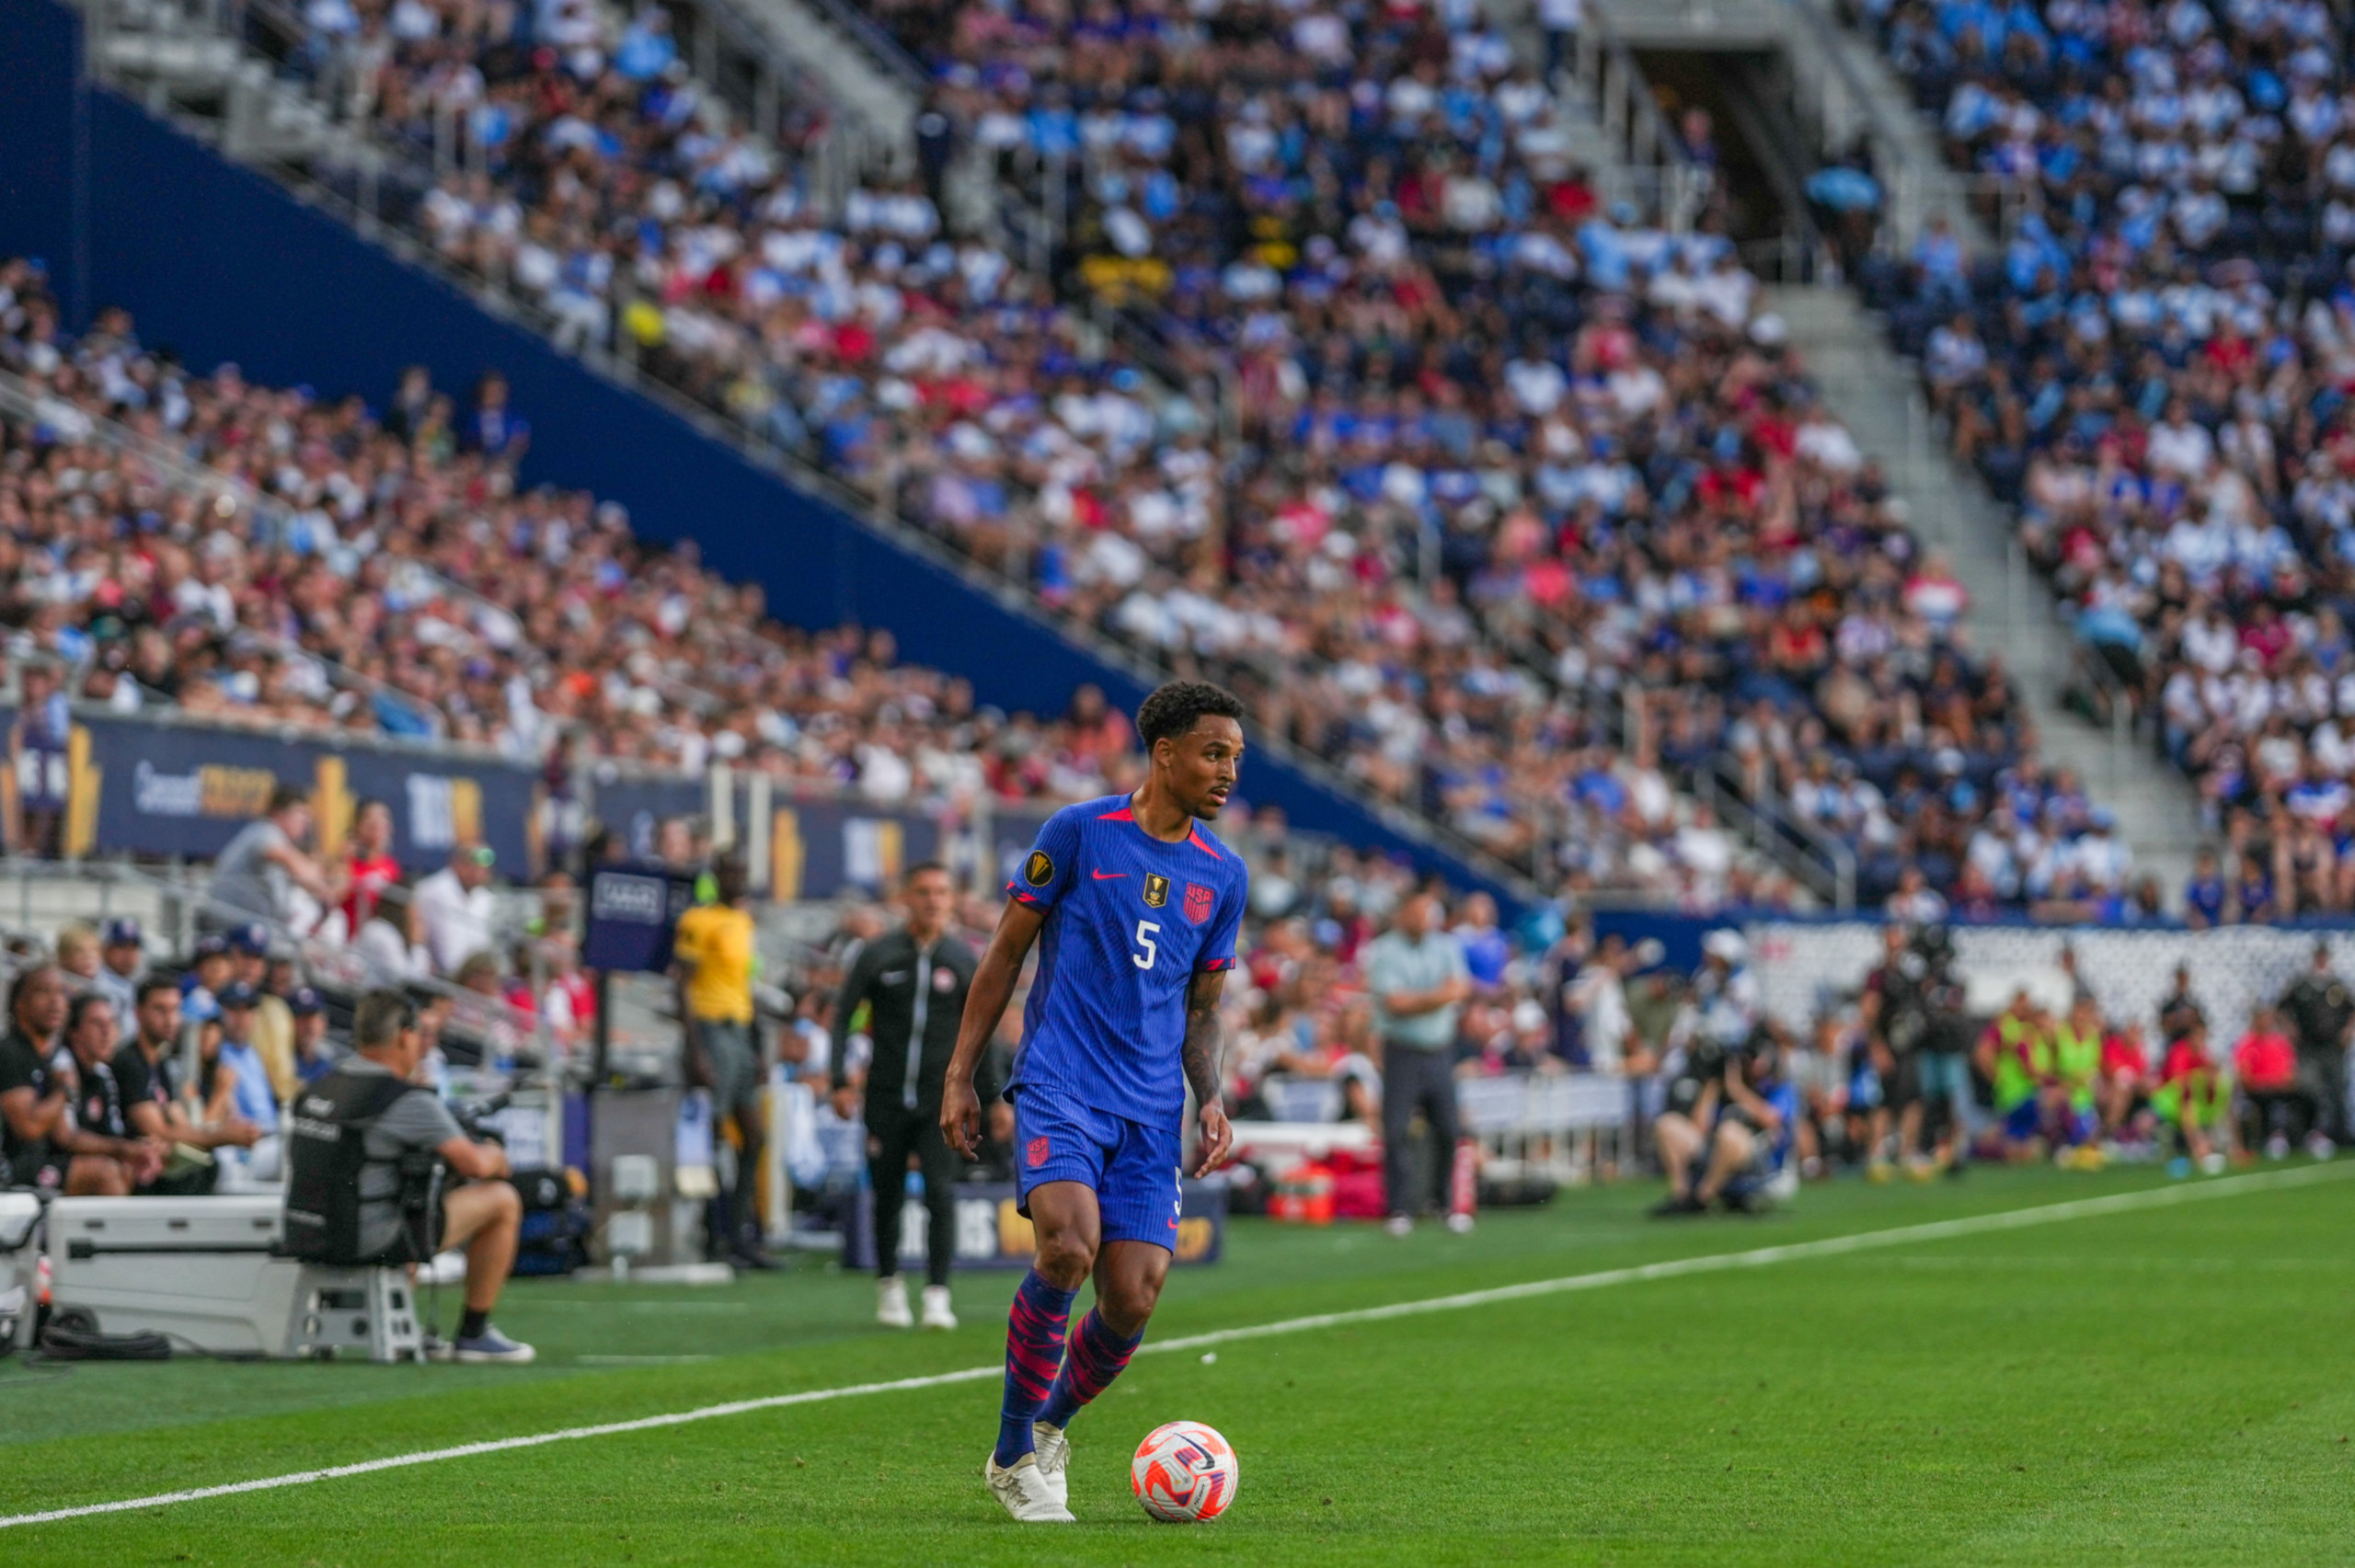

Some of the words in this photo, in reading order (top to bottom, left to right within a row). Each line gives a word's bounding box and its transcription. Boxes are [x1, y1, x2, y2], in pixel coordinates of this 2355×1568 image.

[1188, 885, 1212, 903] USA
[1133, 920, 1161, 970] 5
[1028, 1138, 1048, 1151] USA
